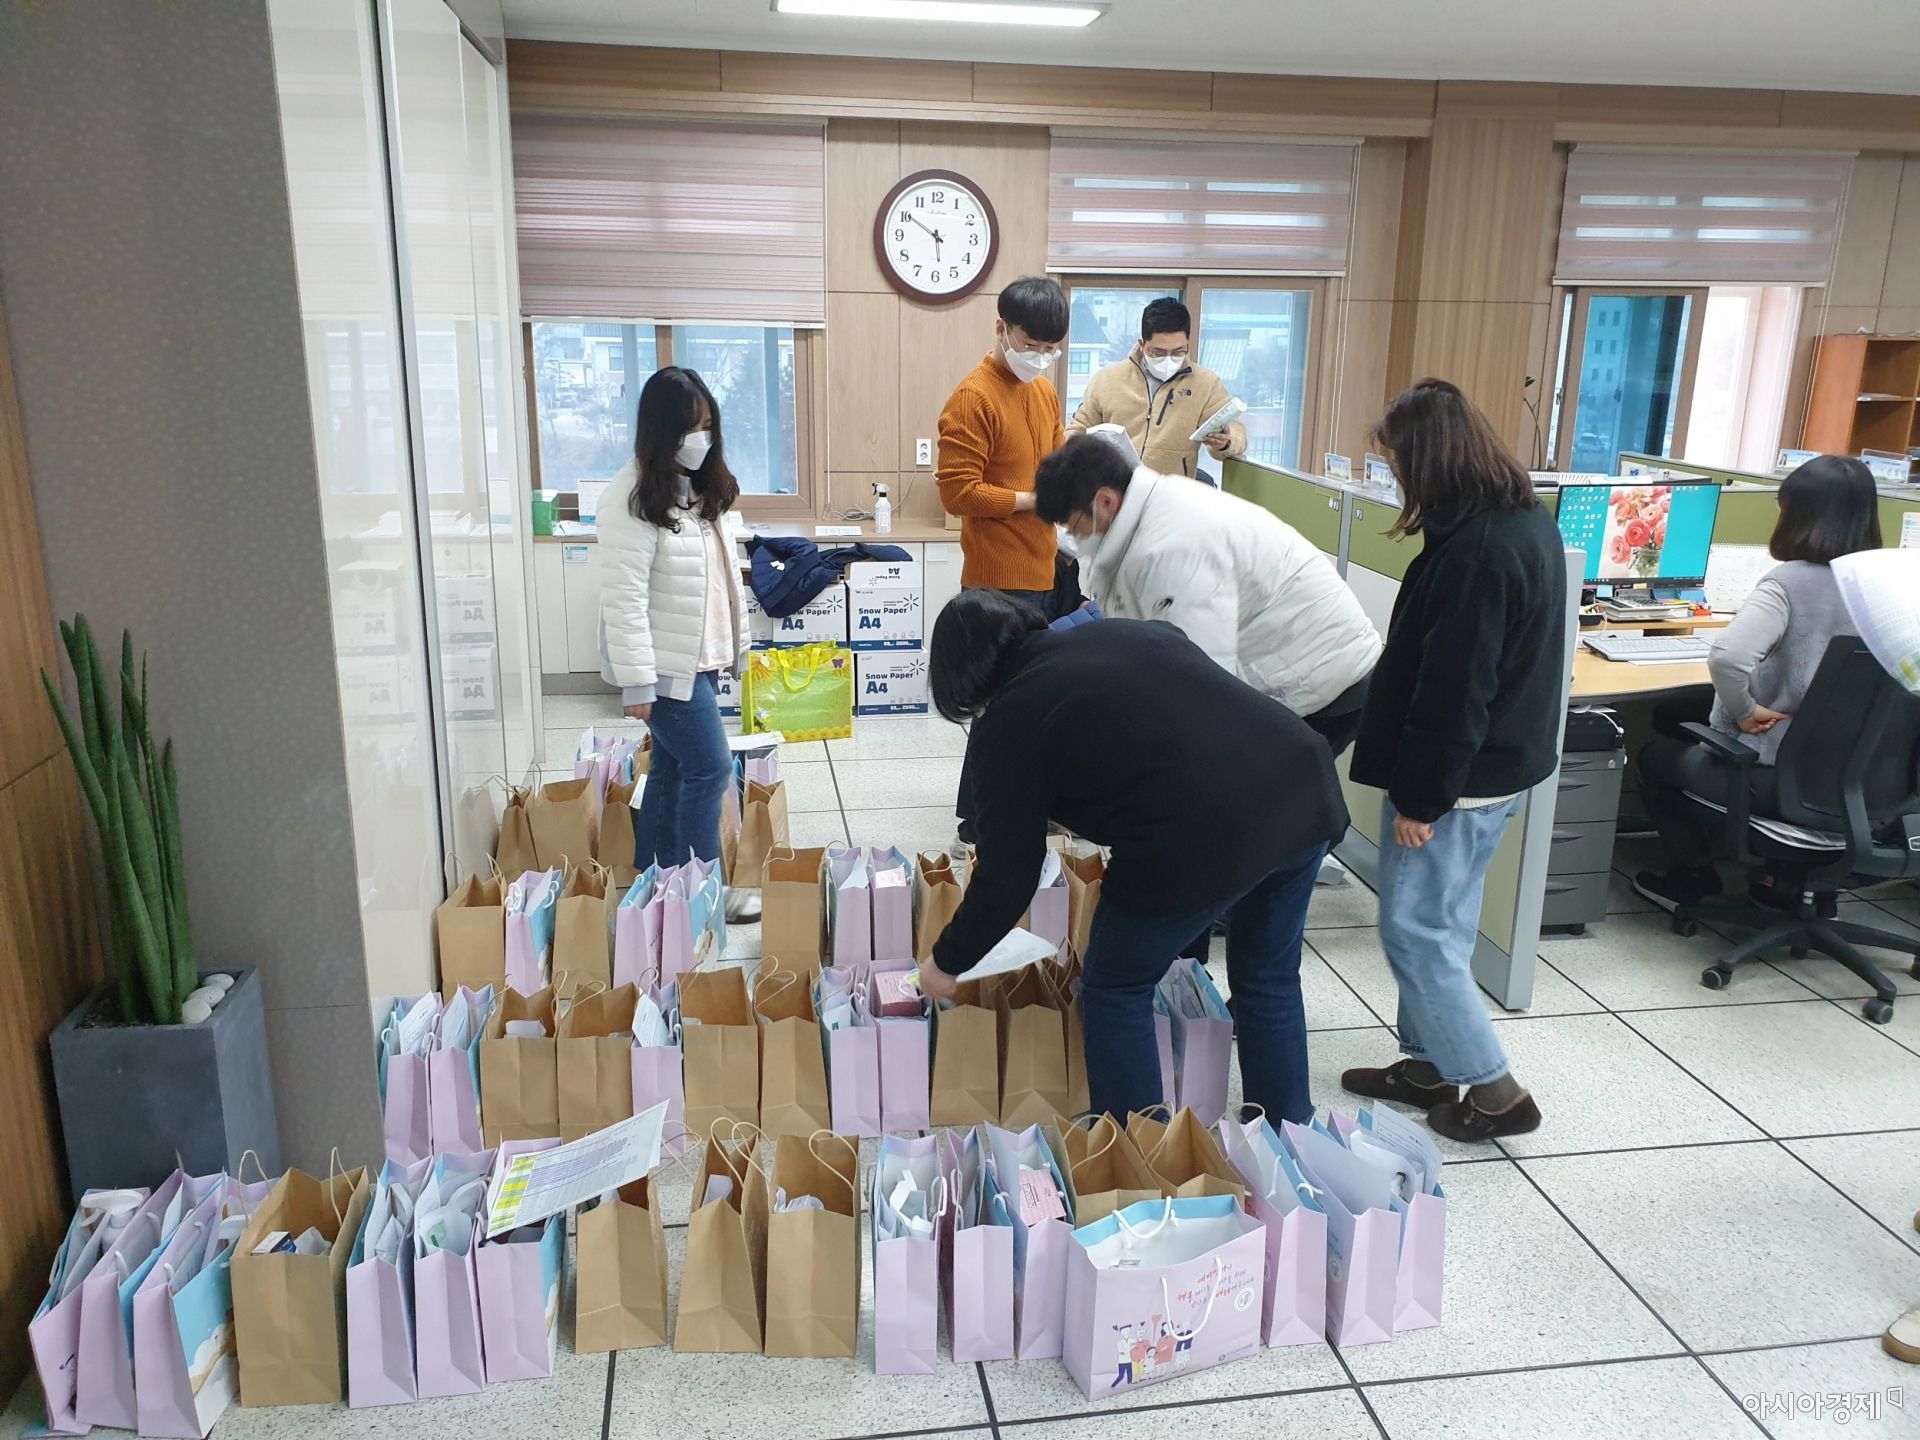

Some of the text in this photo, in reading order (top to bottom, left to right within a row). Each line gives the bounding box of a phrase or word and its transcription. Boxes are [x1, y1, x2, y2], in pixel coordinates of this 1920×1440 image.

[915, 196, 925, 209] 11
[931, 191, 945, 204] 12
[953, 198, 960, 210] 1
[900, 210, 912, 223] 10
[964, 213, 976, 227] 2
[894, 228, 905, 241] 9
[968, 233, 979, 246] 3
[899, 249, 910, 262] 8
[961, 252, 972, 265] 4
[913, 264, 922, 277] 7
[930, 270, 940, 283] 6
[949, 266, 959, 279] 5
[888, 567, 900, 575] A4
[806, 608, 831, 616] Paper
[858, 607, 908, 615] Snow Paper
[781, 616, 805, 631] A4
[858, 615, 882, 629] A4
[890, 672, 914, 680] Paper
[866, 680, 888, 694] A4
